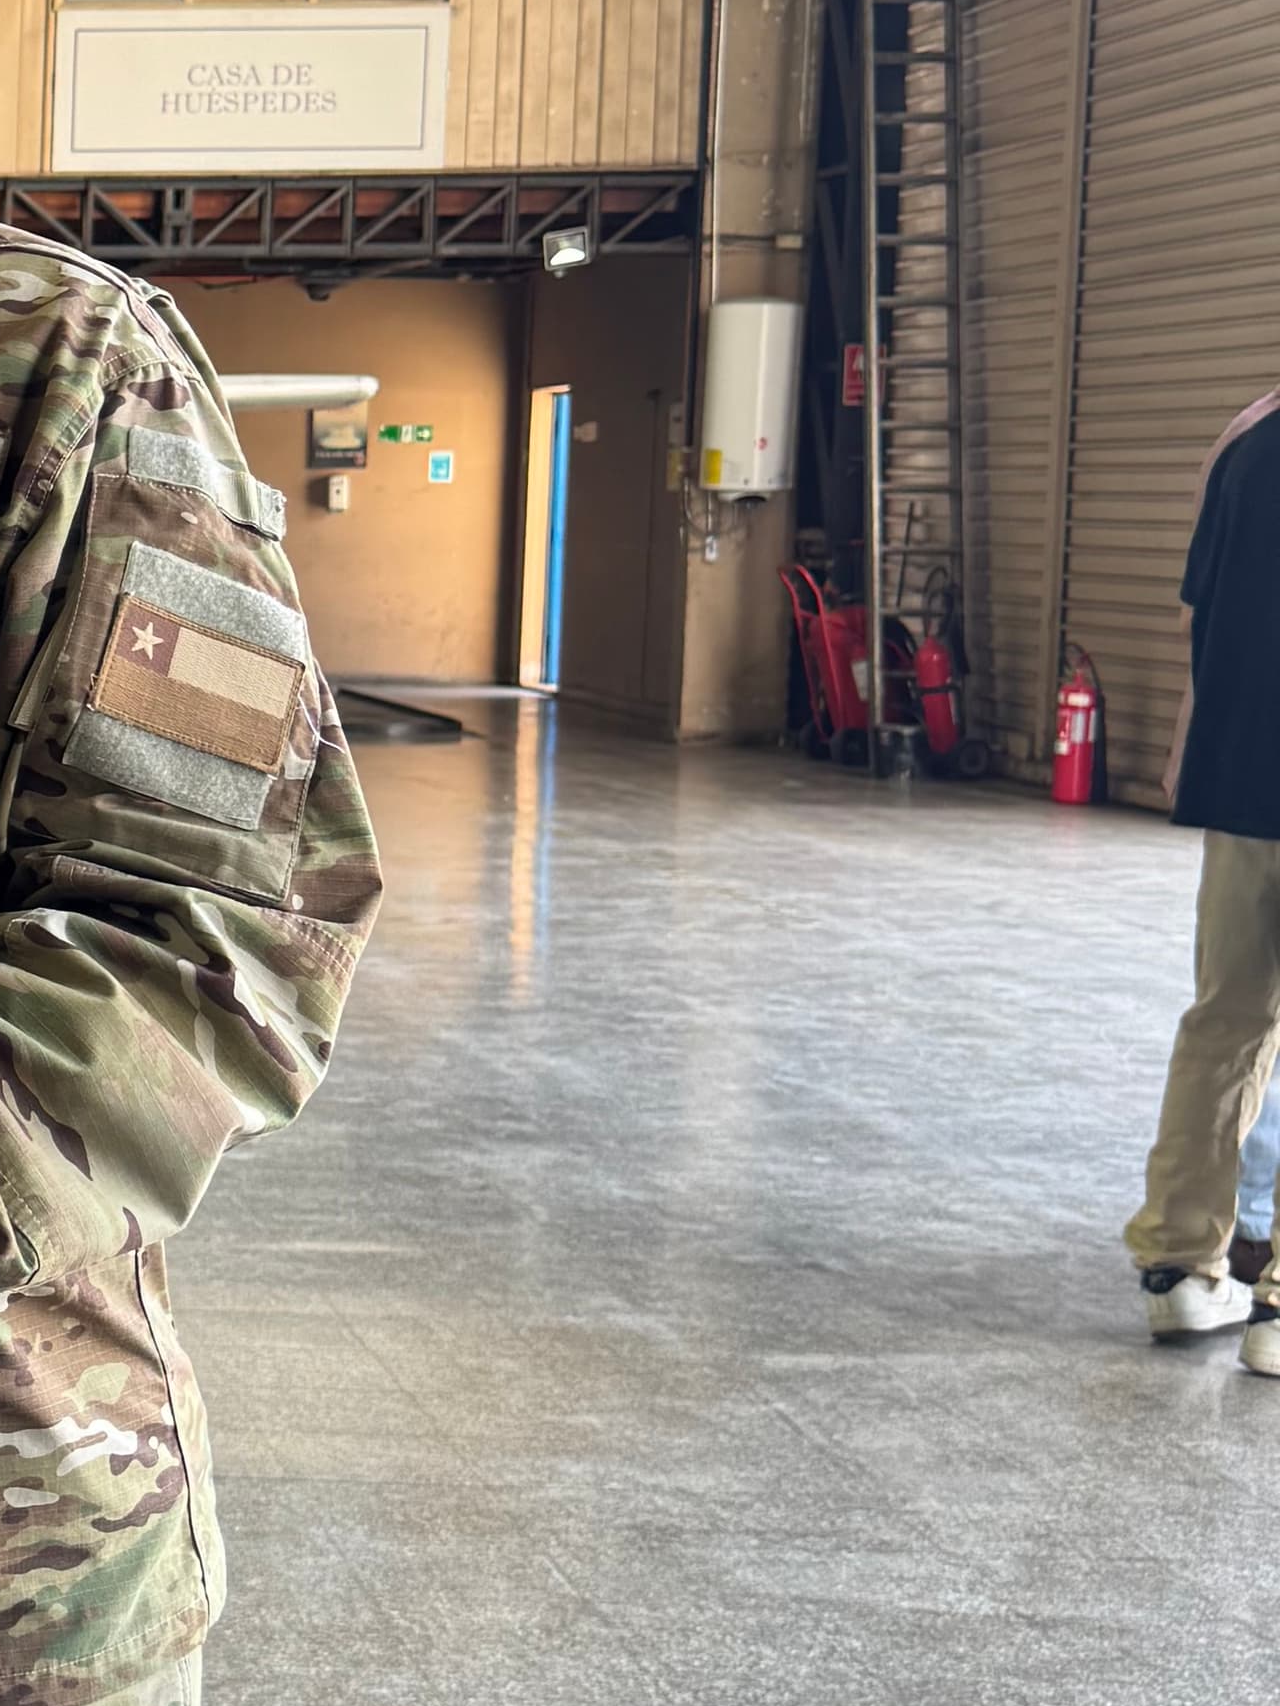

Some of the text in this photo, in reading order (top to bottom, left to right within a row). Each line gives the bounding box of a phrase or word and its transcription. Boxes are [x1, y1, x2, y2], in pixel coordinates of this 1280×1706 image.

[187, 63, 313, 86] CASA DE
[161, 88, 337, 114] HUÉSPEDES
